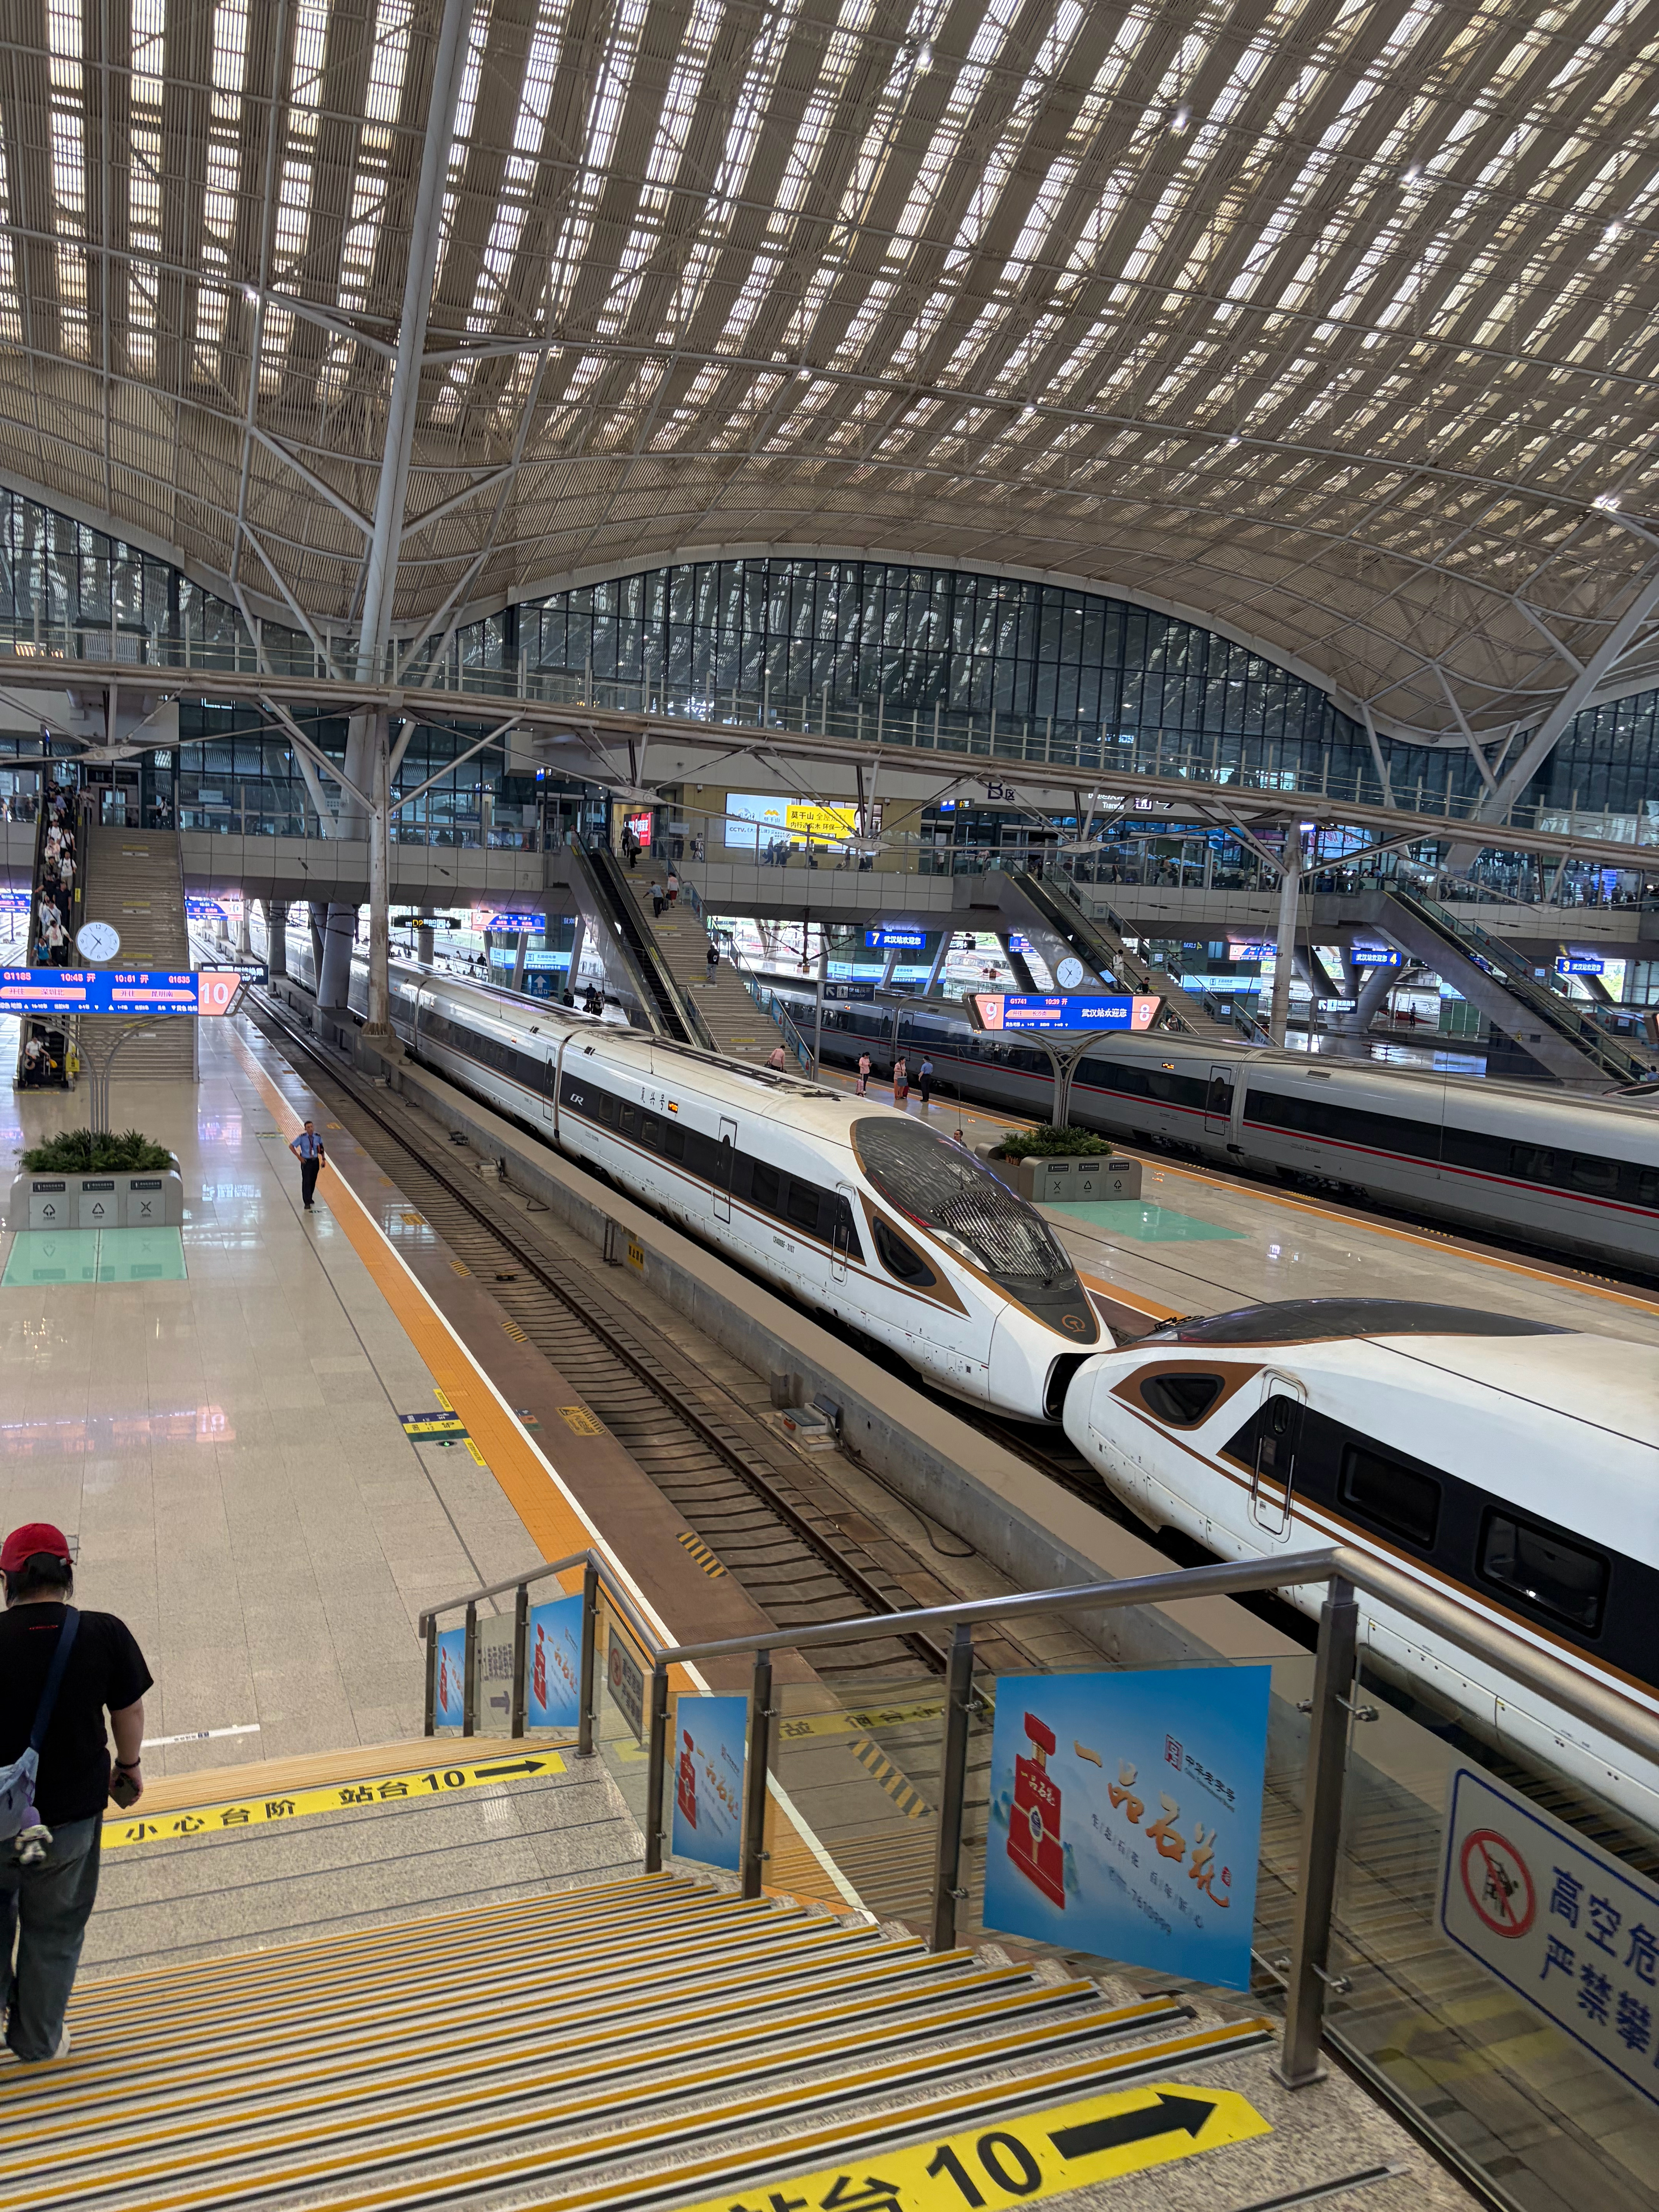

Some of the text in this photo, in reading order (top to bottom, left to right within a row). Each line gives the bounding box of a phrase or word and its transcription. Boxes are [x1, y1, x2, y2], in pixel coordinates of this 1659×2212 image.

[791, 811, 814, 819] 莫干山
[229, 903, 240, 914] 10
[476, 914, 483, 924] 9
[872, 933, 880, 945] 7
[1389, 953, 1397, 964] 4
[1563, 961, 1570, 971] 3
[86, 973, 96, 982] 开
[140, 974, 149, 983] 开
[200, 982, 229, 1004] 10
[986, 1003, 997, 1020] 9
[1139, 1004, 1150, 1021] 8
[126, 1771, 465, 1842] 小心台阶 站台 10
[1548, 1865, 1659, 1987] 高空危
[1539, 1932, 1659, 2077] 严禁攀
[927, 2132, 1043, 2209] 10
